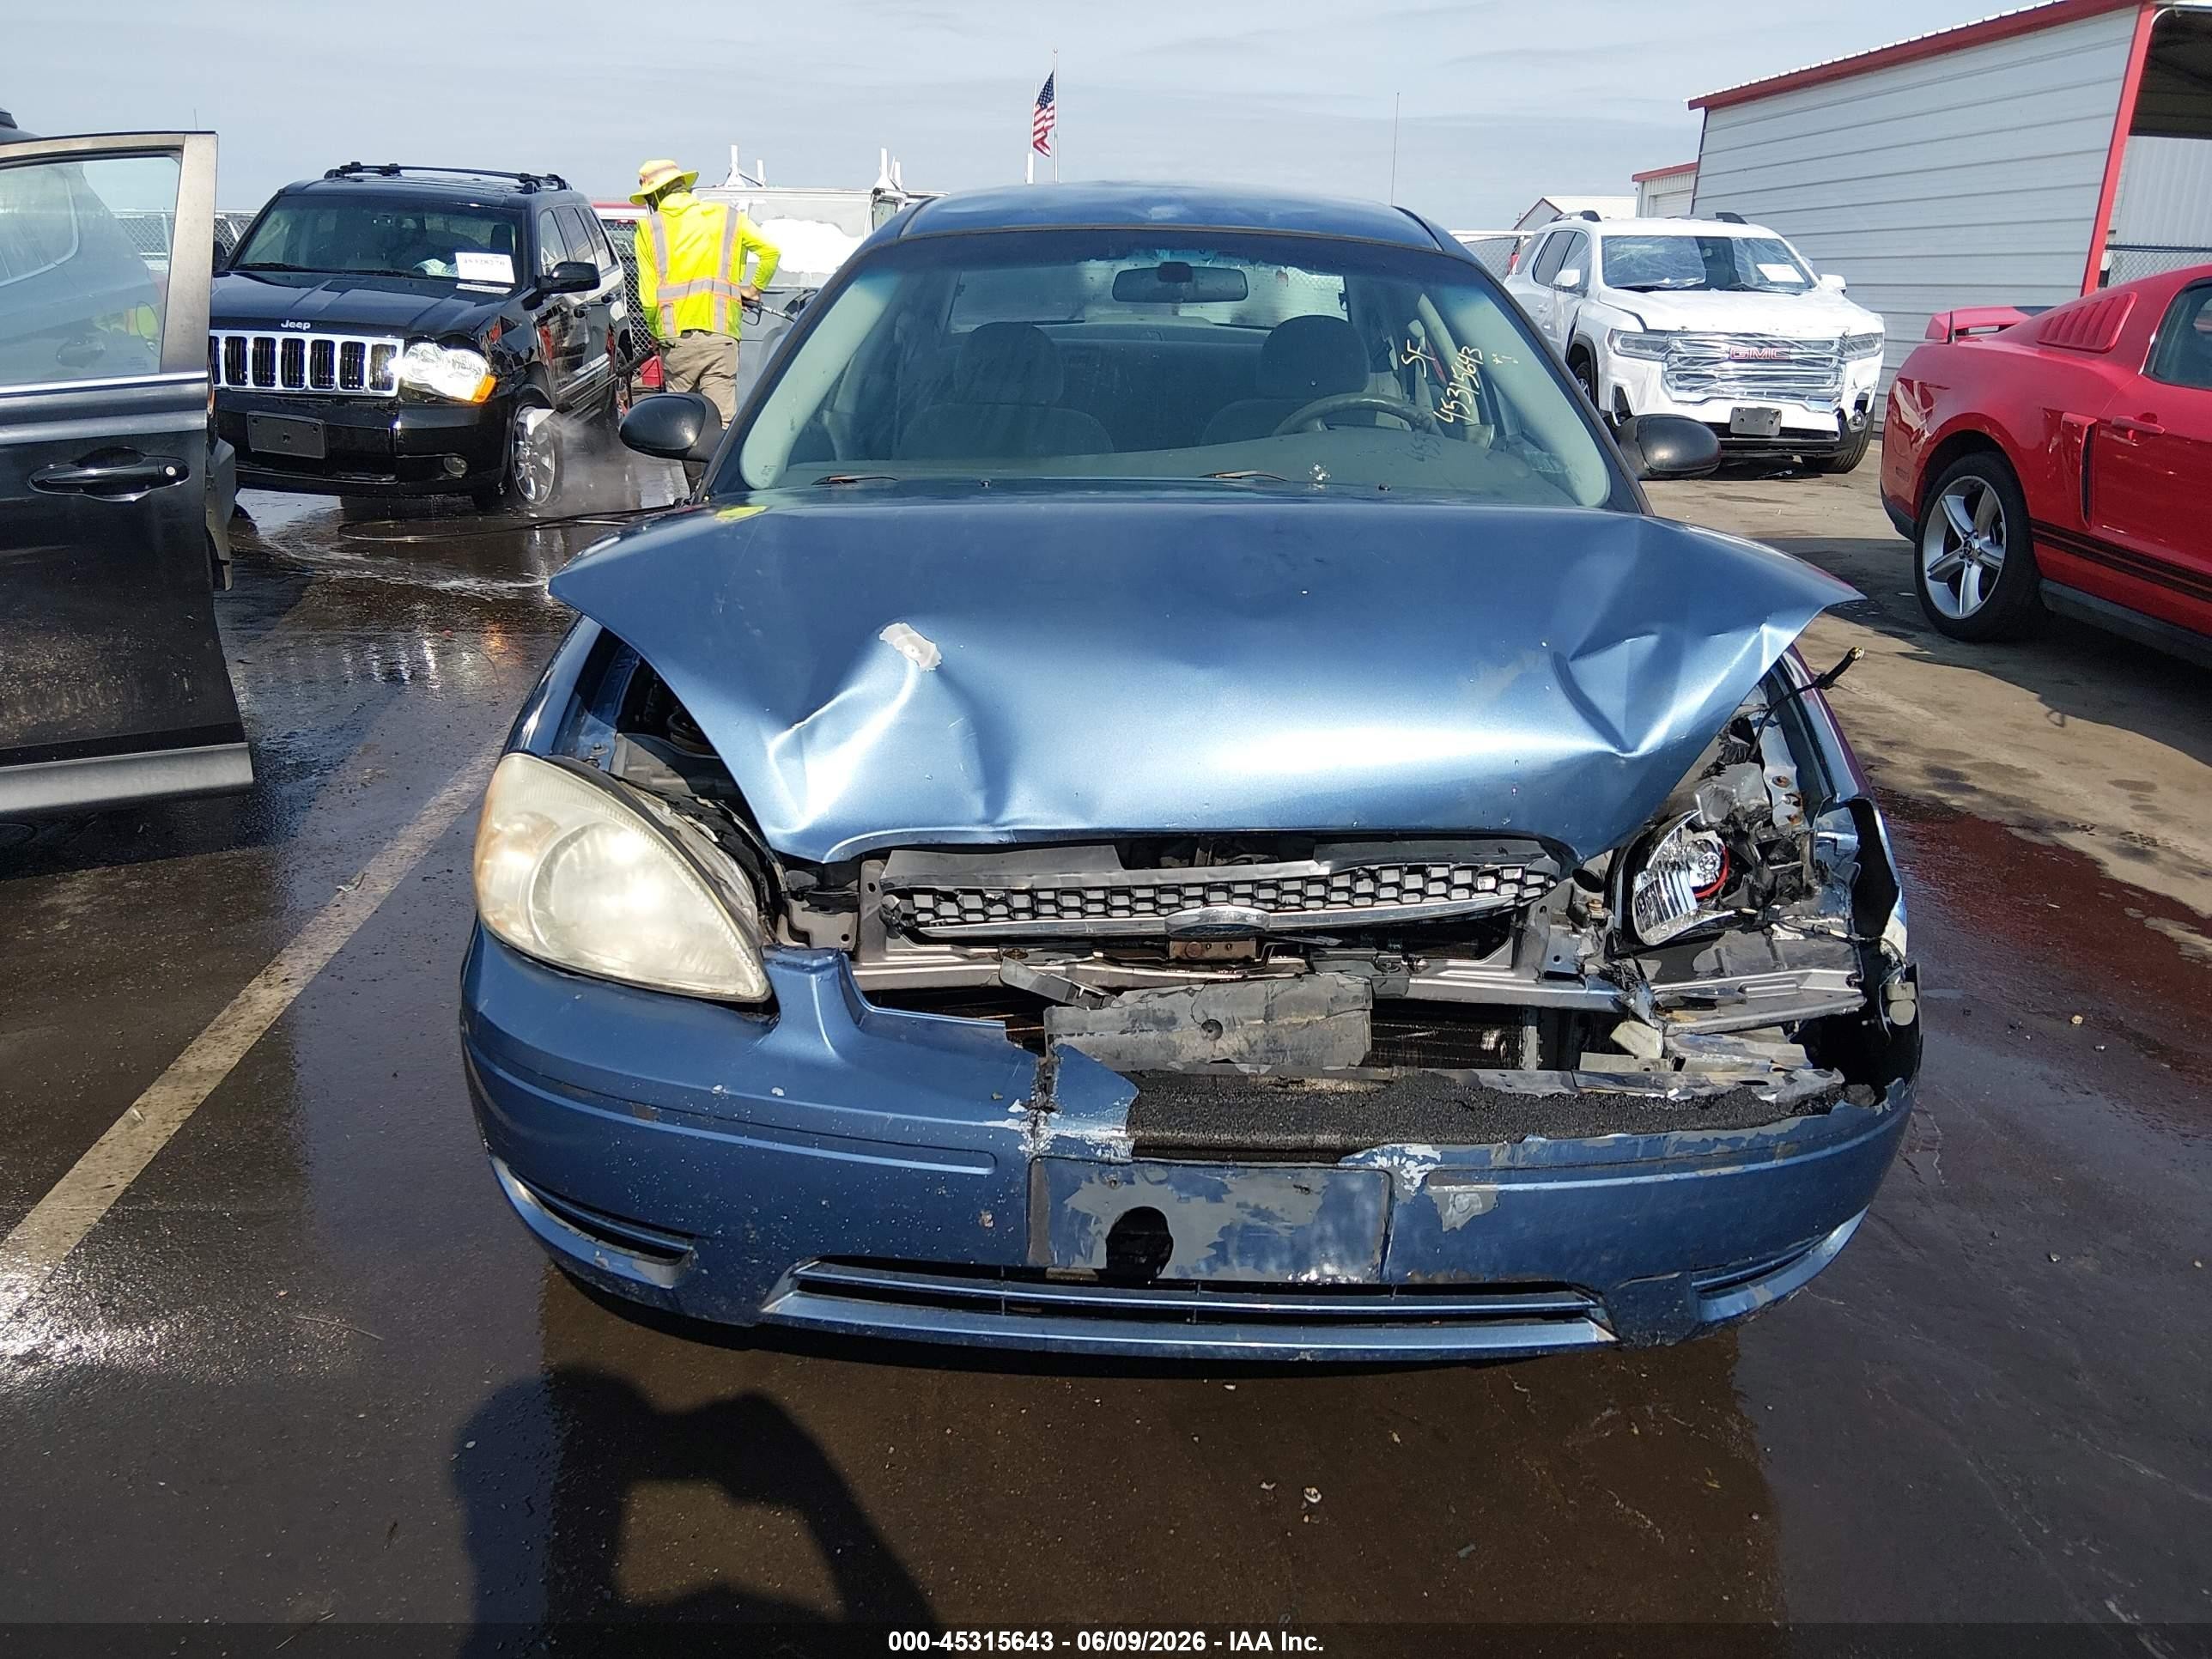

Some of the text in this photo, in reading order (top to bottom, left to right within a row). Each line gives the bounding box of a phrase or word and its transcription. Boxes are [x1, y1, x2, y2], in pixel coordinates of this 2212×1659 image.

[280, 319, 312, 331] Jeep
[1729, 346, 1791, 361] GMC
[1432, 344, 1484, 425] 45315643
